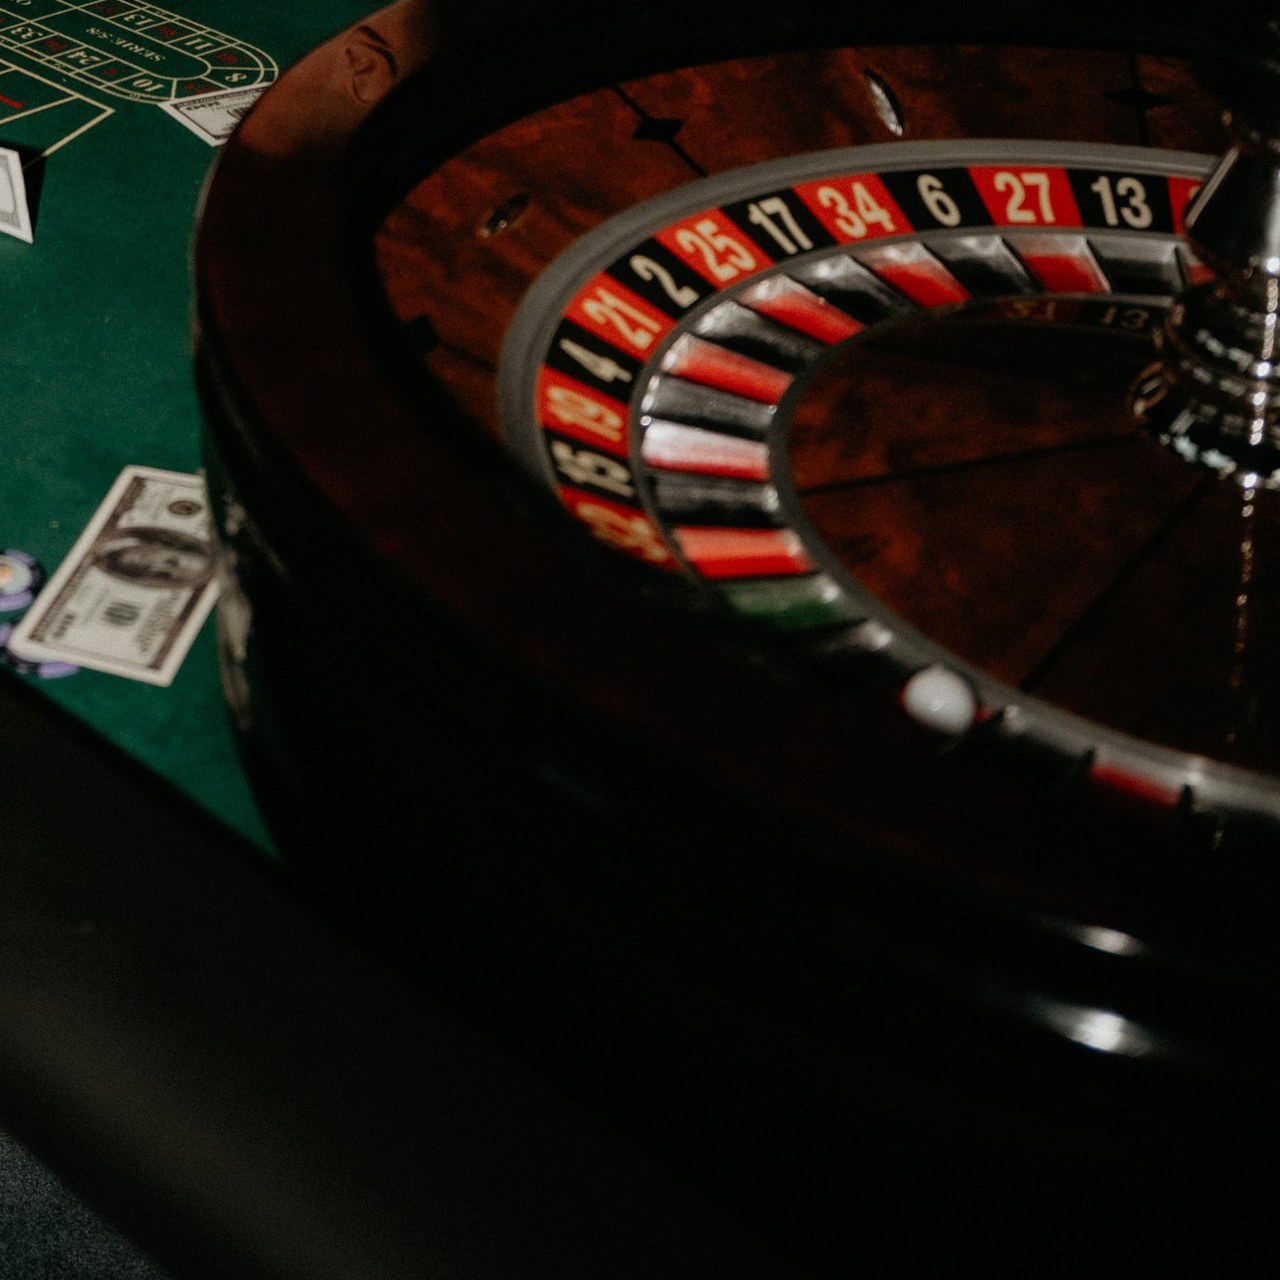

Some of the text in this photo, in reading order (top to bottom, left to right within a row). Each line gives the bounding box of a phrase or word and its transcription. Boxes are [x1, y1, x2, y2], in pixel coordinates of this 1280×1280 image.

[746, 195, 816, 256] 17
[816, 180, 898, 239] 34
[915, 172, 963, 228] 6
[992, 170, 1057, 226] 27
[1089, 173, 1154, 230] 13
[674, 217, 757, 284] 25
[628, 252, 701, 310] 2
[581, 287, 663, 351] 21
[558, 336, 634, 384] 4
